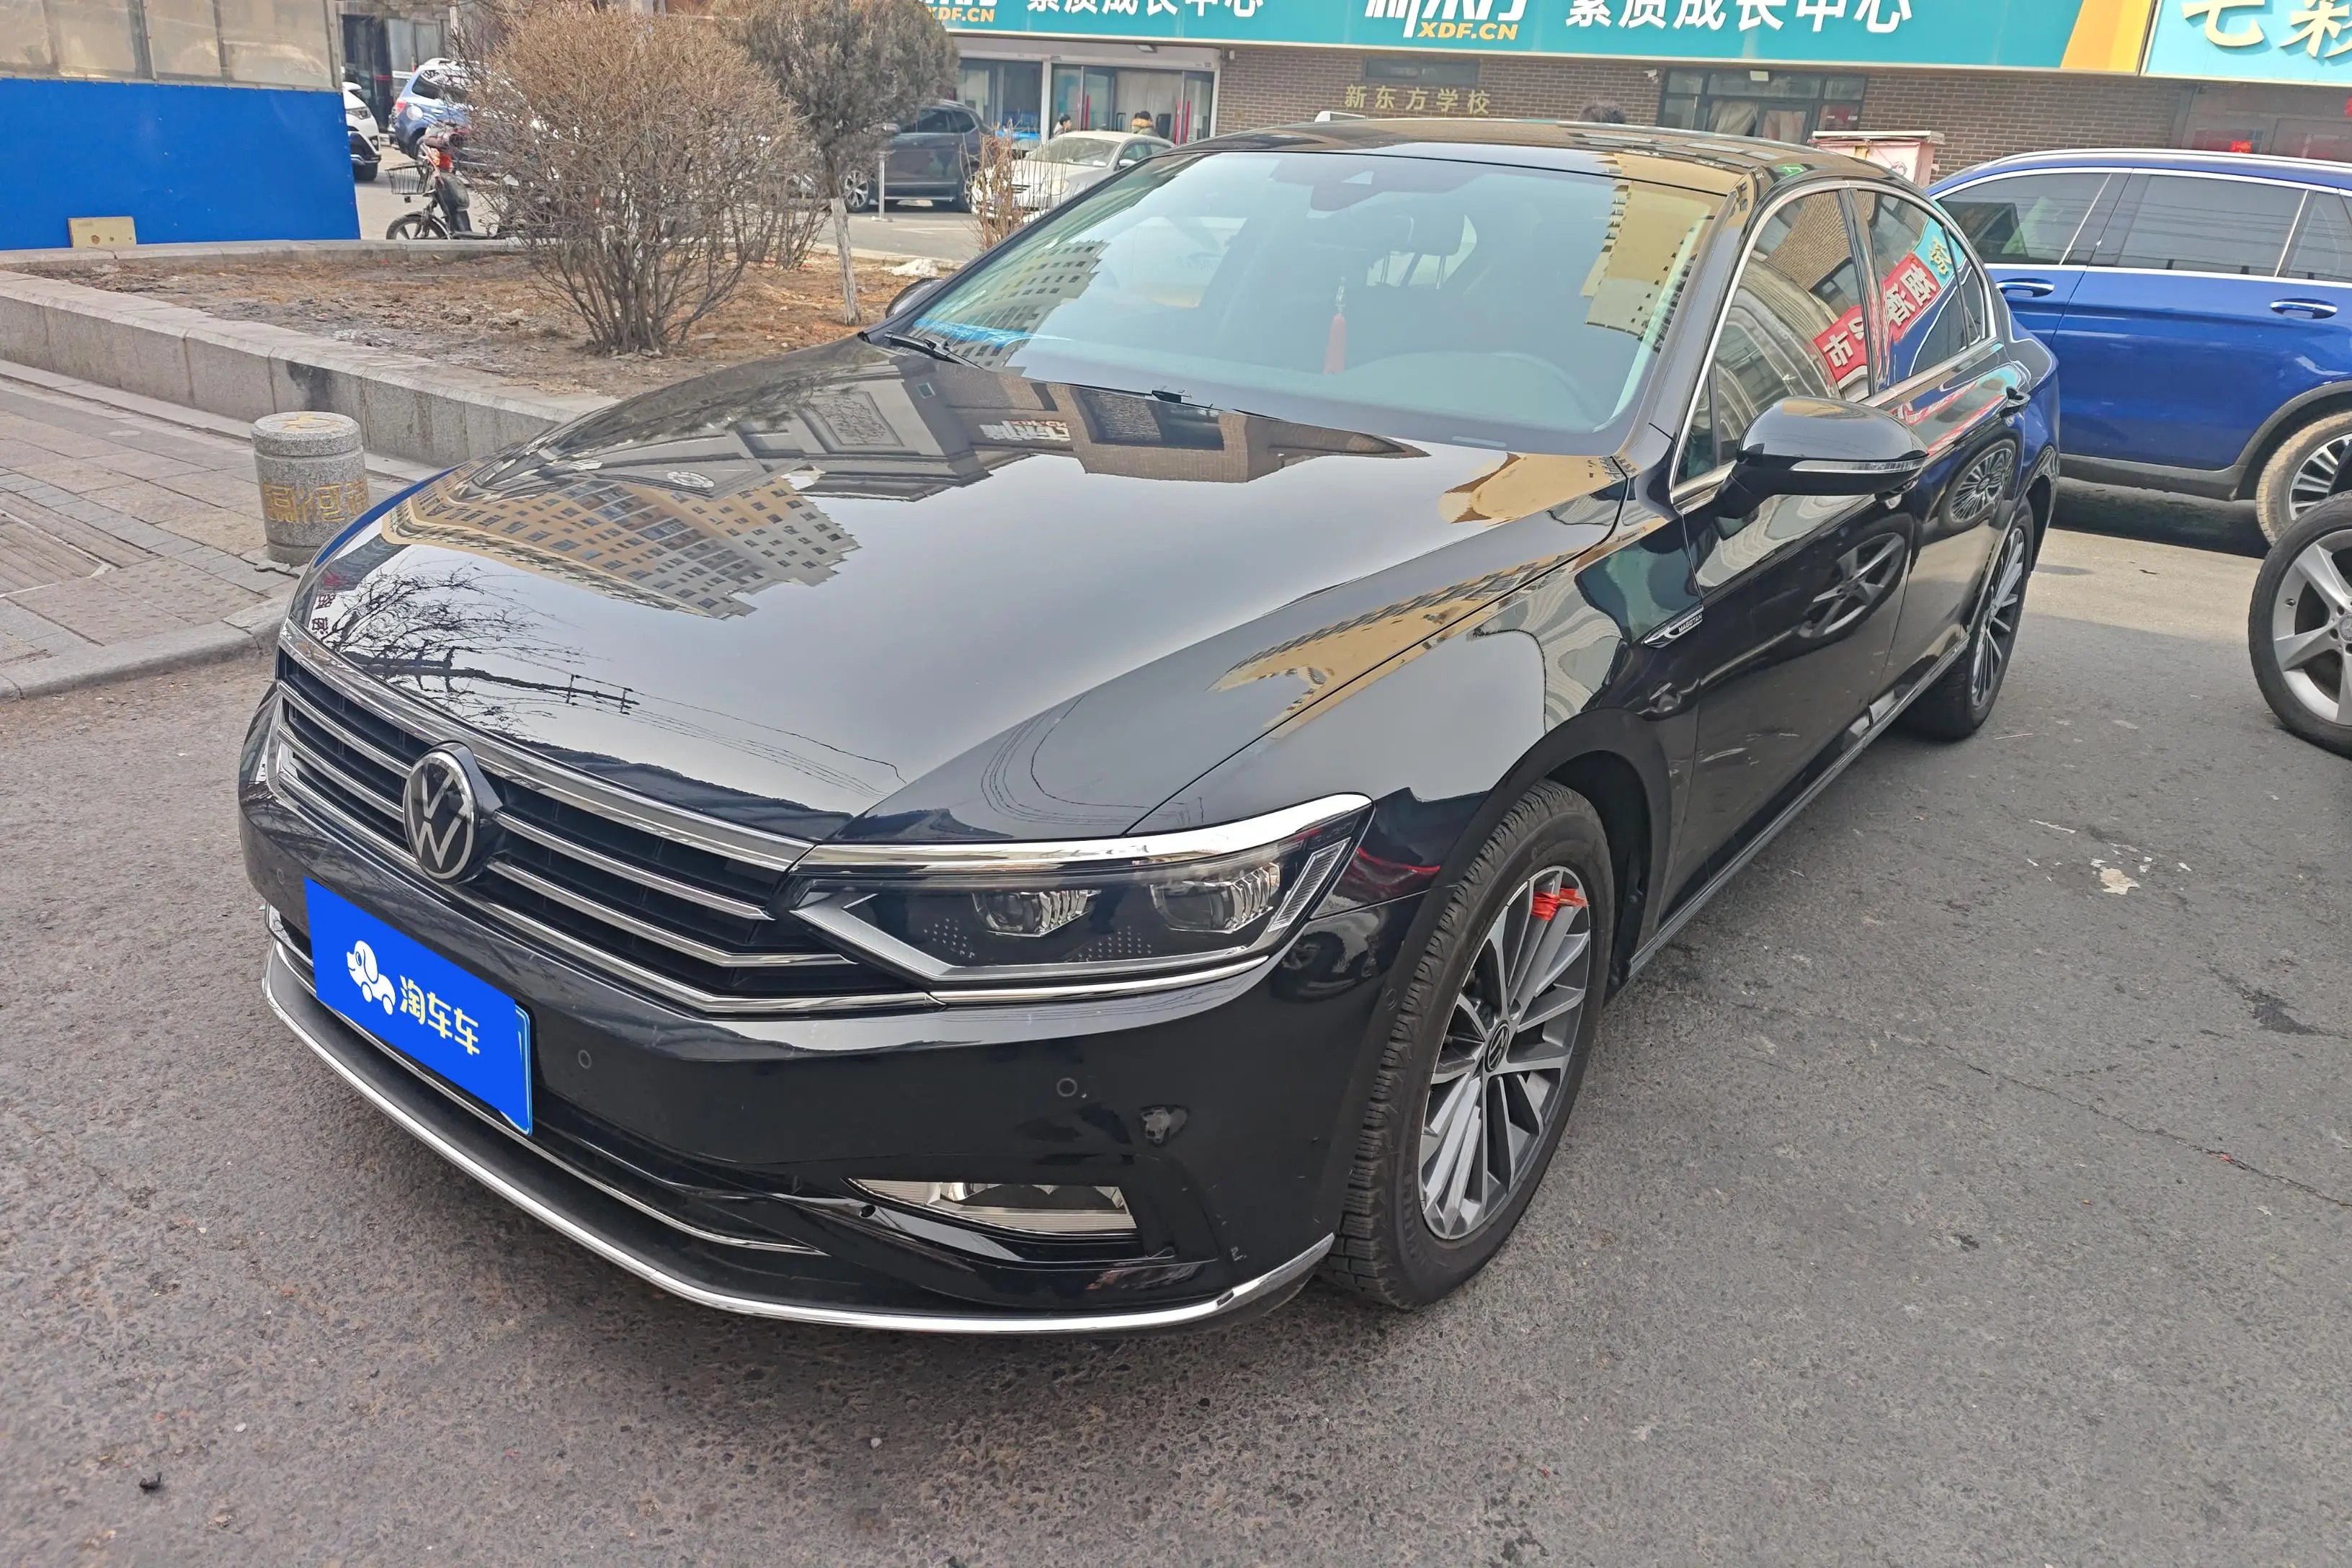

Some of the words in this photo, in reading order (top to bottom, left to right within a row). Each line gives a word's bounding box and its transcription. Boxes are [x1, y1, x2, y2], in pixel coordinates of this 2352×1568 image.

[1417, 22, 1518, 40] XDF.CN
[1345, 84, 1491, 115] 新东方学校
[1678, 612, 1703, 633] MAGOTAN
